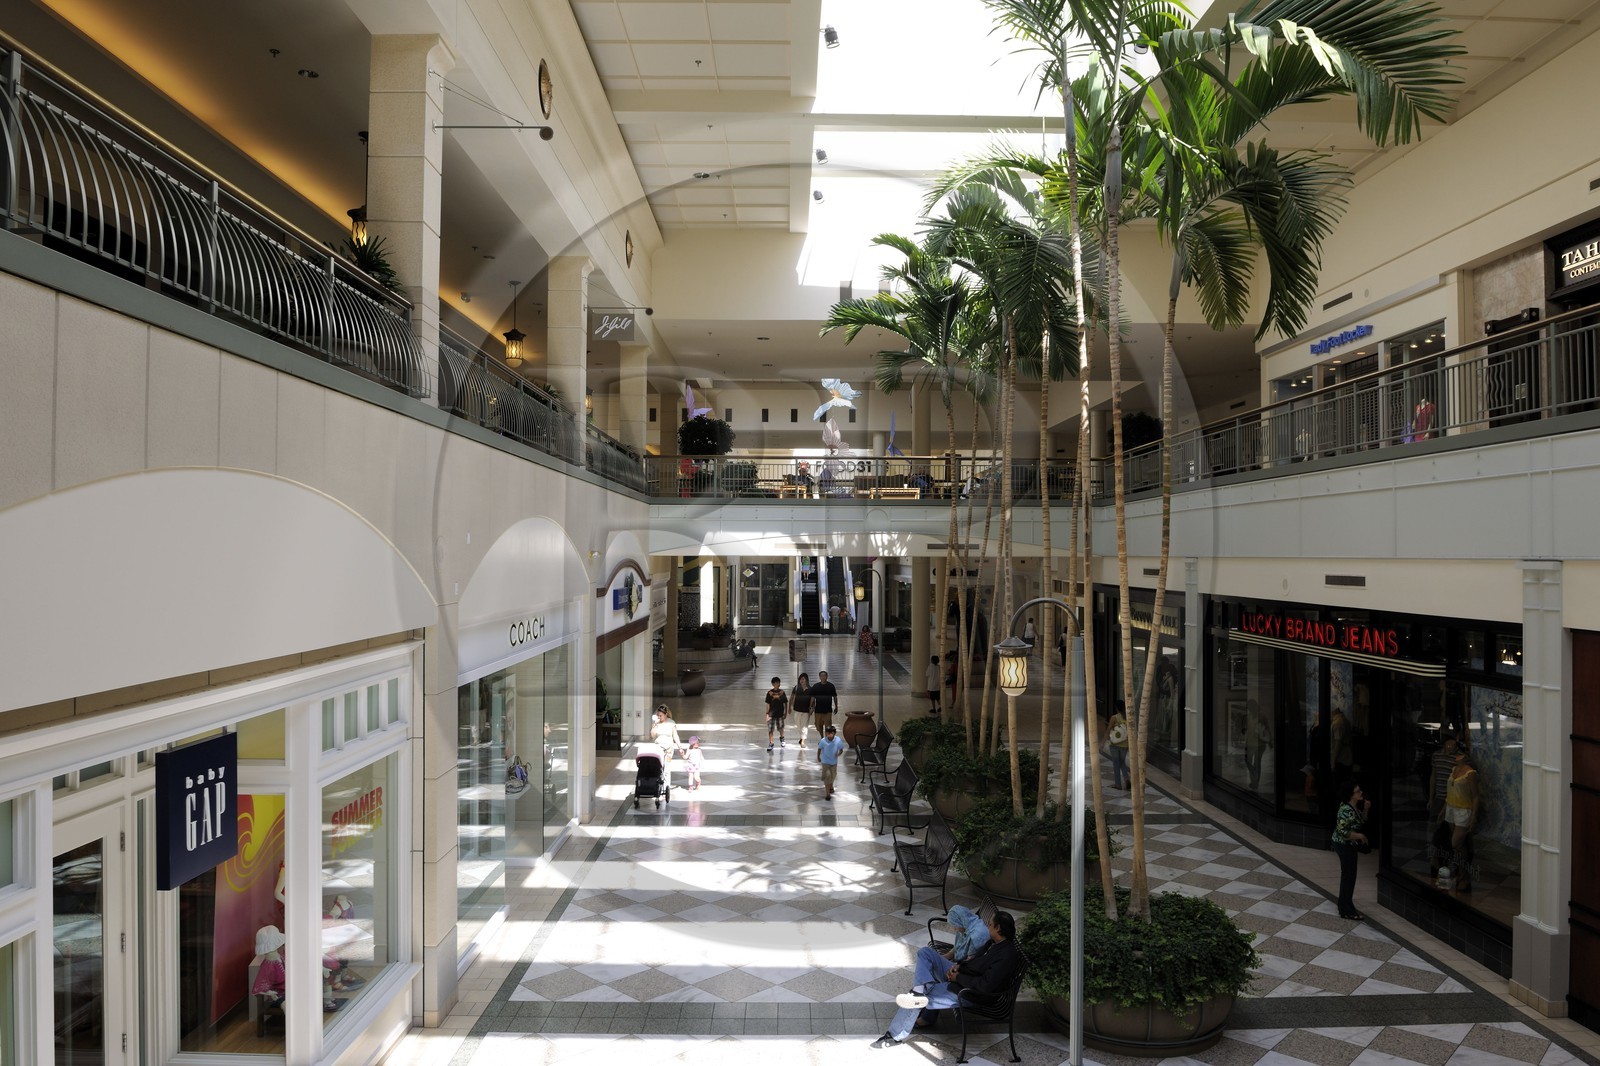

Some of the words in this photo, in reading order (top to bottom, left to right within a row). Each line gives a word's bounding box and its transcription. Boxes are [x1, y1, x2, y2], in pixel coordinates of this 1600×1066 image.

[1561, 240, 1600, 267] TAH
[1327, 335, 1343, 348] Foot
[1342, 325, 1374, 344] Locker
[509, 616, 545, 647] COACH
[1242, 613, 1283, 638] LUCKY
[1287, 618, 1336, 646] BRAND
[1341, 624, 1399, 656] JEANS
[185, 765, 226, 789] baby
[185, 781, 226, 852] GAP
[331, 786, 383, 826] SUMMER
